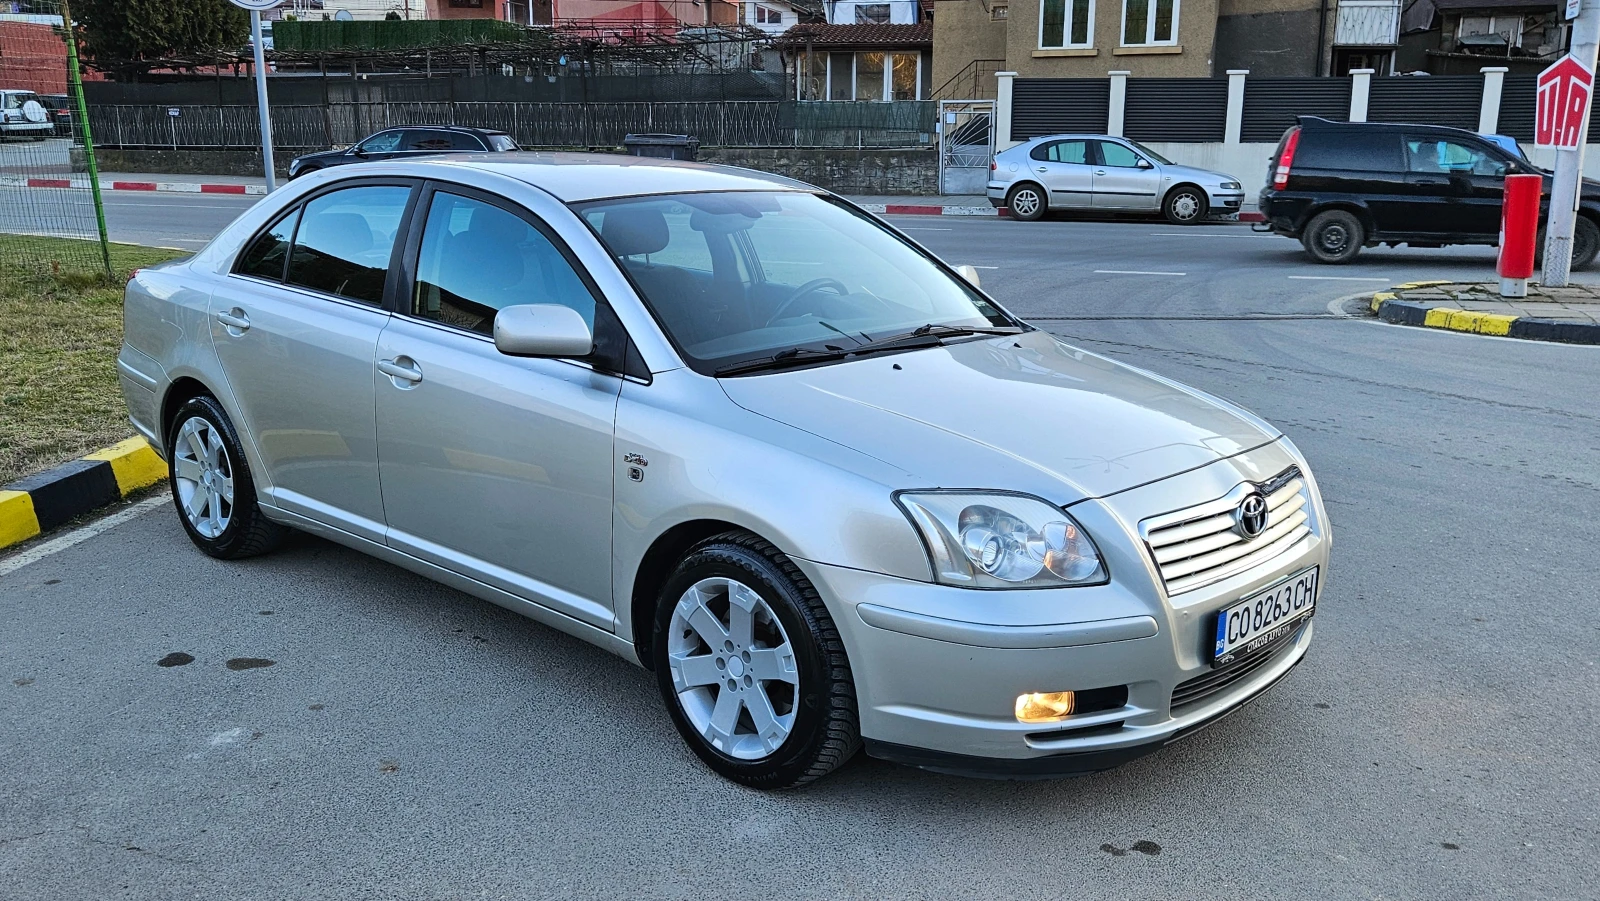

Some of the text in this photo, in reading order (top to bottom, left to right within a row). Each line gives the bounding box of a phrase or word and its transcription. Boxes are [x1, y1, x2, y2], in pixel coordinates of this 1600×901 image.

[1537, 57, 1592, 146] UTA
[1215, 639, 1225, 651] BG
[1229, 574, 1314, 645] CO 8263 CH
